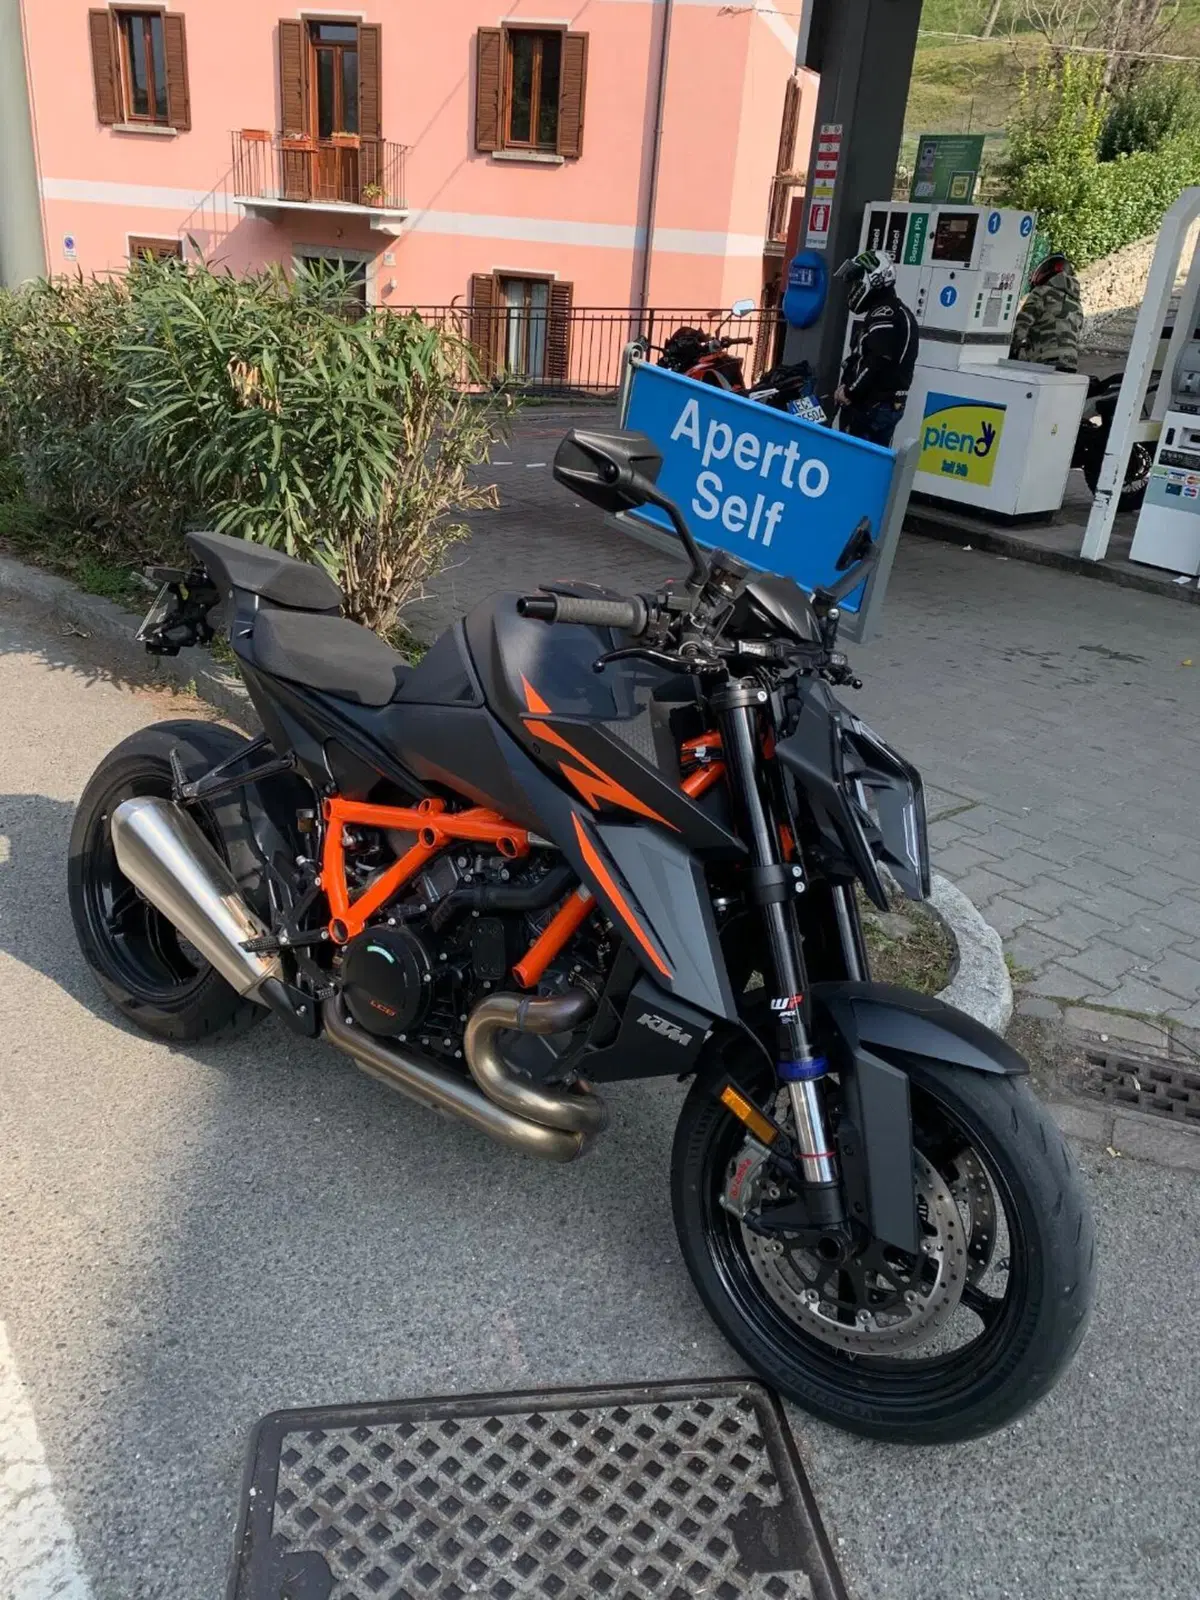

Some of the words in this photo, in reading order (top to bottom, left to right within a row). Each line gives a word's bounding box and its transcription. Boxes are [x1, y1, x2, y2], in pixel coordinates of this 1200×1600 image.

[914, 217, 923, 230] Pb
[1022, 219, 1030, 234] 2
[910, 234, 920, 262] Senza
[670, 398, 830, 498] Aperto
[691, 470, 785, 548] Self
[770, 994, 804, 1010] WP
[636, 1012, 693, 1047] KTM
